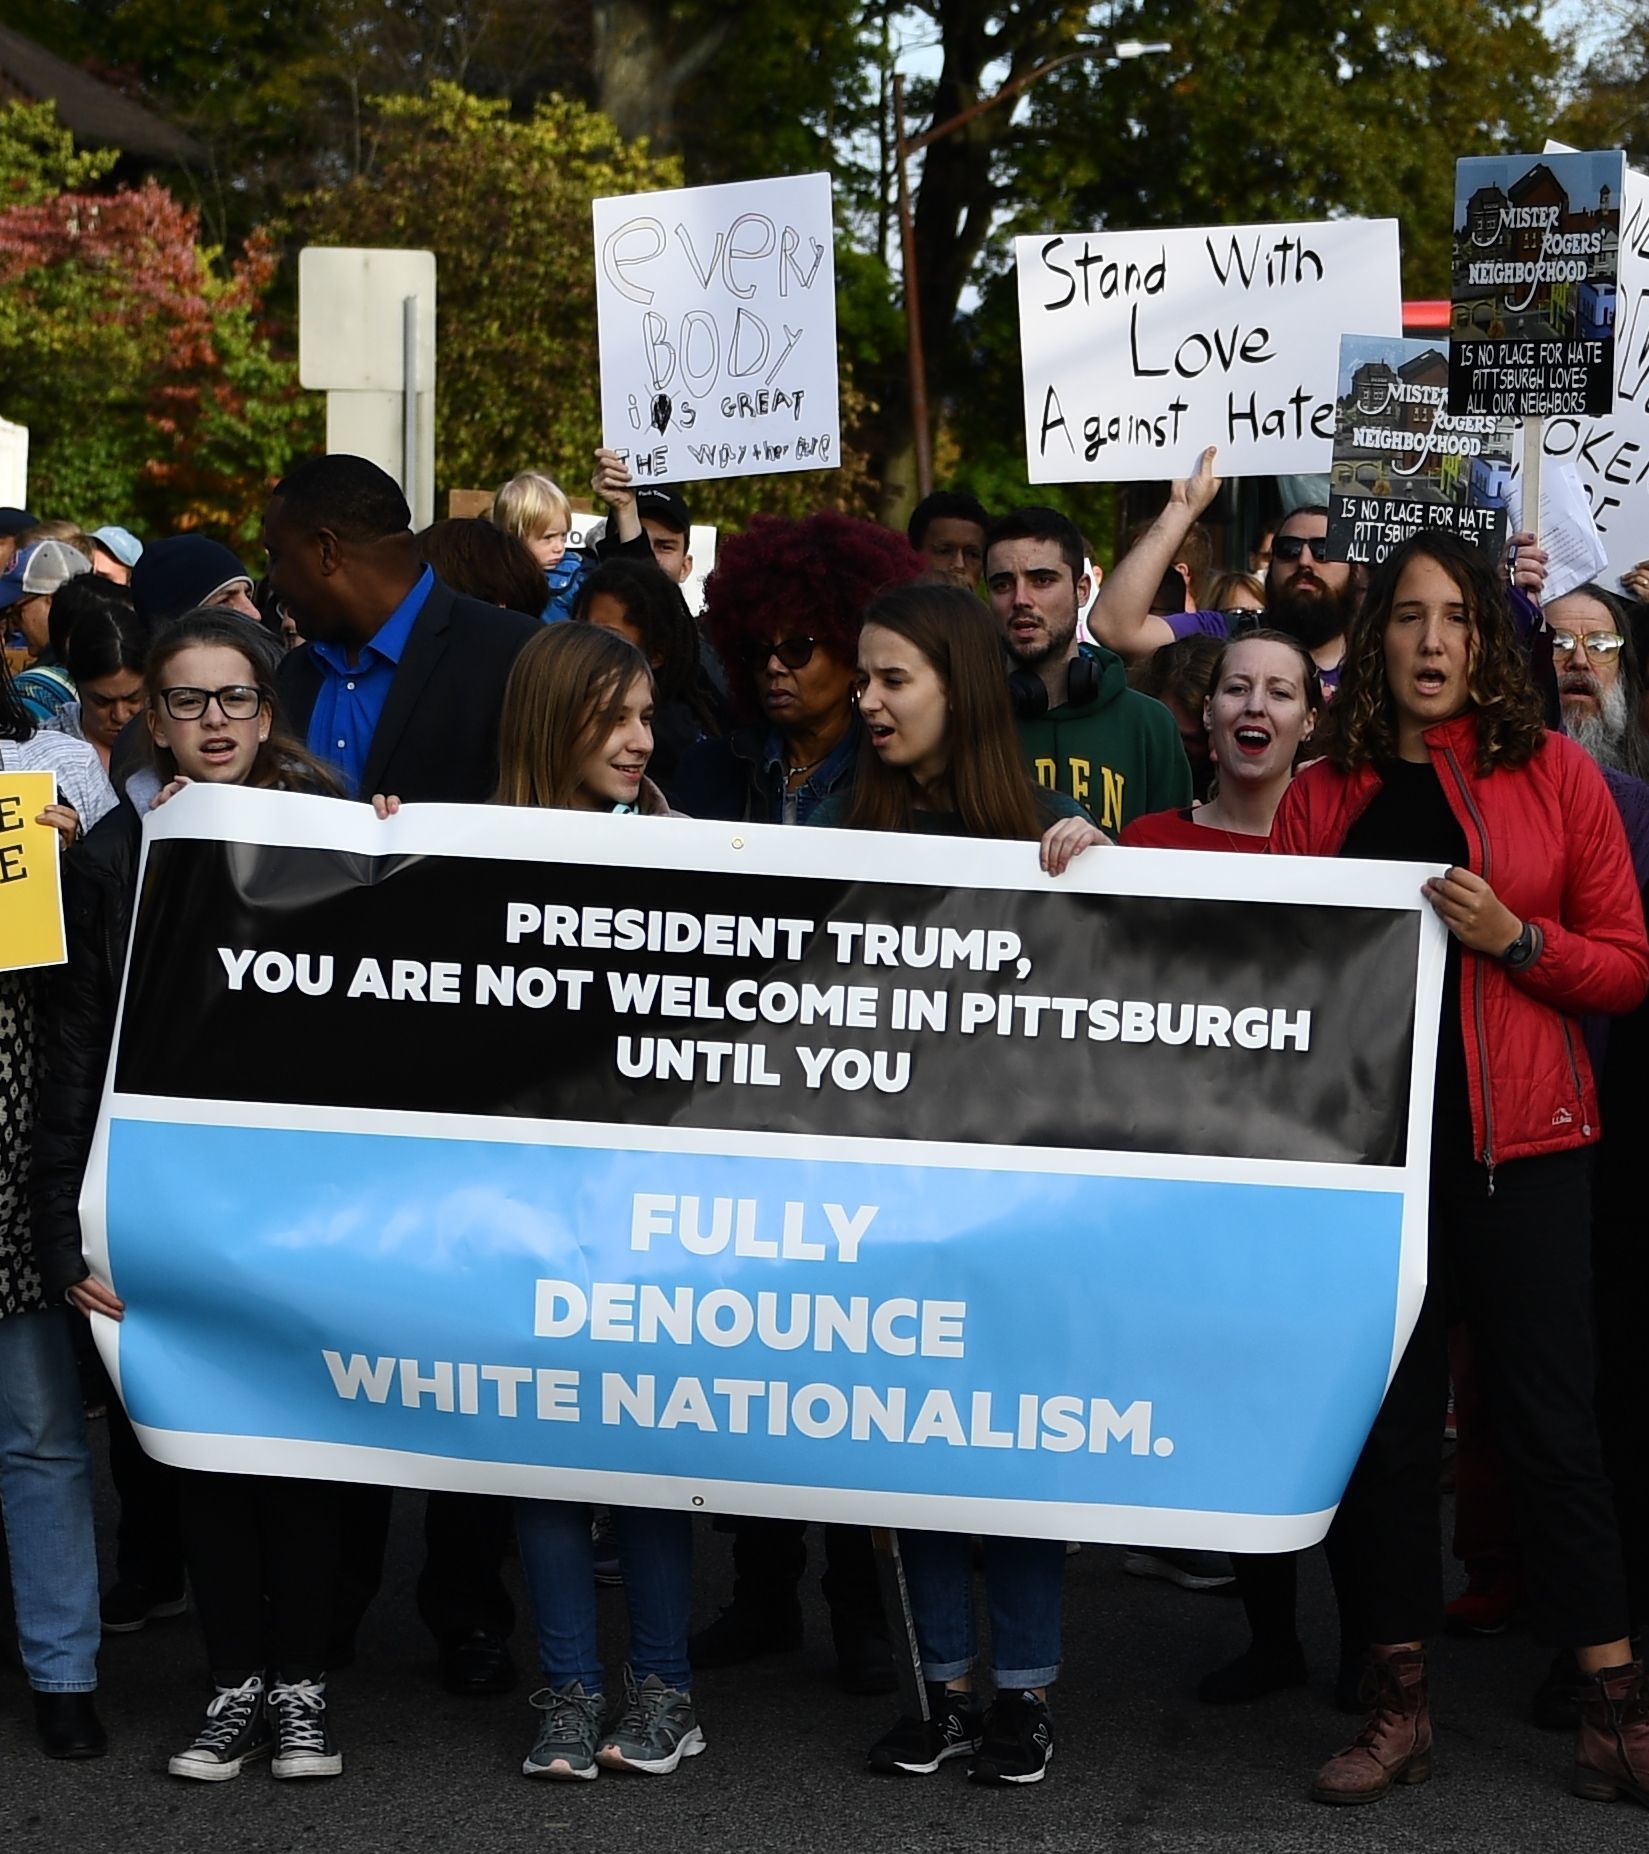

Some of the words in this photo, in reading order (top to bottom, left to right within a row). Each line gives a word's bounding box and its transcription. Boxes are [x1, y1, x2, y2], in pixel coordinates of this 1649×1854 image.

[1482, 203, 1561, 240] MISTER
[1542, 228, 1605, 256] ROGERS'
[1041, 237, 1166, 310] Stand
[1206, 234, 1324, 290] With
[1468, 261, 1587, 297] NEIGHBORHOOD
[1130, 302, 1277, 378] Love
[1460, 345, 1473, 367] IS
[1478, 345, 1495, 366] NO
[1500, 344, 1535, 365] PLACE
[1539, 343, 1562, 365] FOR
[1568, 341, 1602, 364] HATE
[1472, 367, 1545, 391] PITTSBURGH
[1549, 367, 1588, 389] LOVES
[720, 388, 804, 421] GREAT
[1466, 394, 1486, 415] ALL
[1492, 393, 1515, 414] OUR
[1520, 391, 1586, 415] NEIGHBORS
[1041, 384, 1189, 462] Against
[1227, 384, 1335, 444] Hate
[1352, 428, 1481, 466] NEIGHBORHOOD
[1341, 498, 1356, 518] IS
[1361, 501, 1379, 520] NO
[1384, 502, 1423, 524] PLACE
[1429, 506, 1453, 526] FOR
[1458, 508, 1496, 530] HATE
[1346, 544, 1370, 563] ALL
[506, 902, 815, 961] PRESIDENT
[826, 921, 1032, 979] TRUMP,
[217, 947, 334, 996] YOU
[346, 957, 462, 1004] ARE
[475, 964, 594, 1011] NOT
[606, 971, 879, 1029] WELCOME
[891, 988, 948, 1032] IN
[960, 992, 1311, 1052] PITTSBURGH
[616, 1035, 781, 1086] UNTIL
[795, 1046, 911, 1093] YOU
[630, 1192, 881, 1263] FULLY
[533, 1277, 967, 1358] DENOUNCE
[322, 1349, 580, 1422] WHITE
[602, 1372, 1175, 1458] NATIONALISM.
